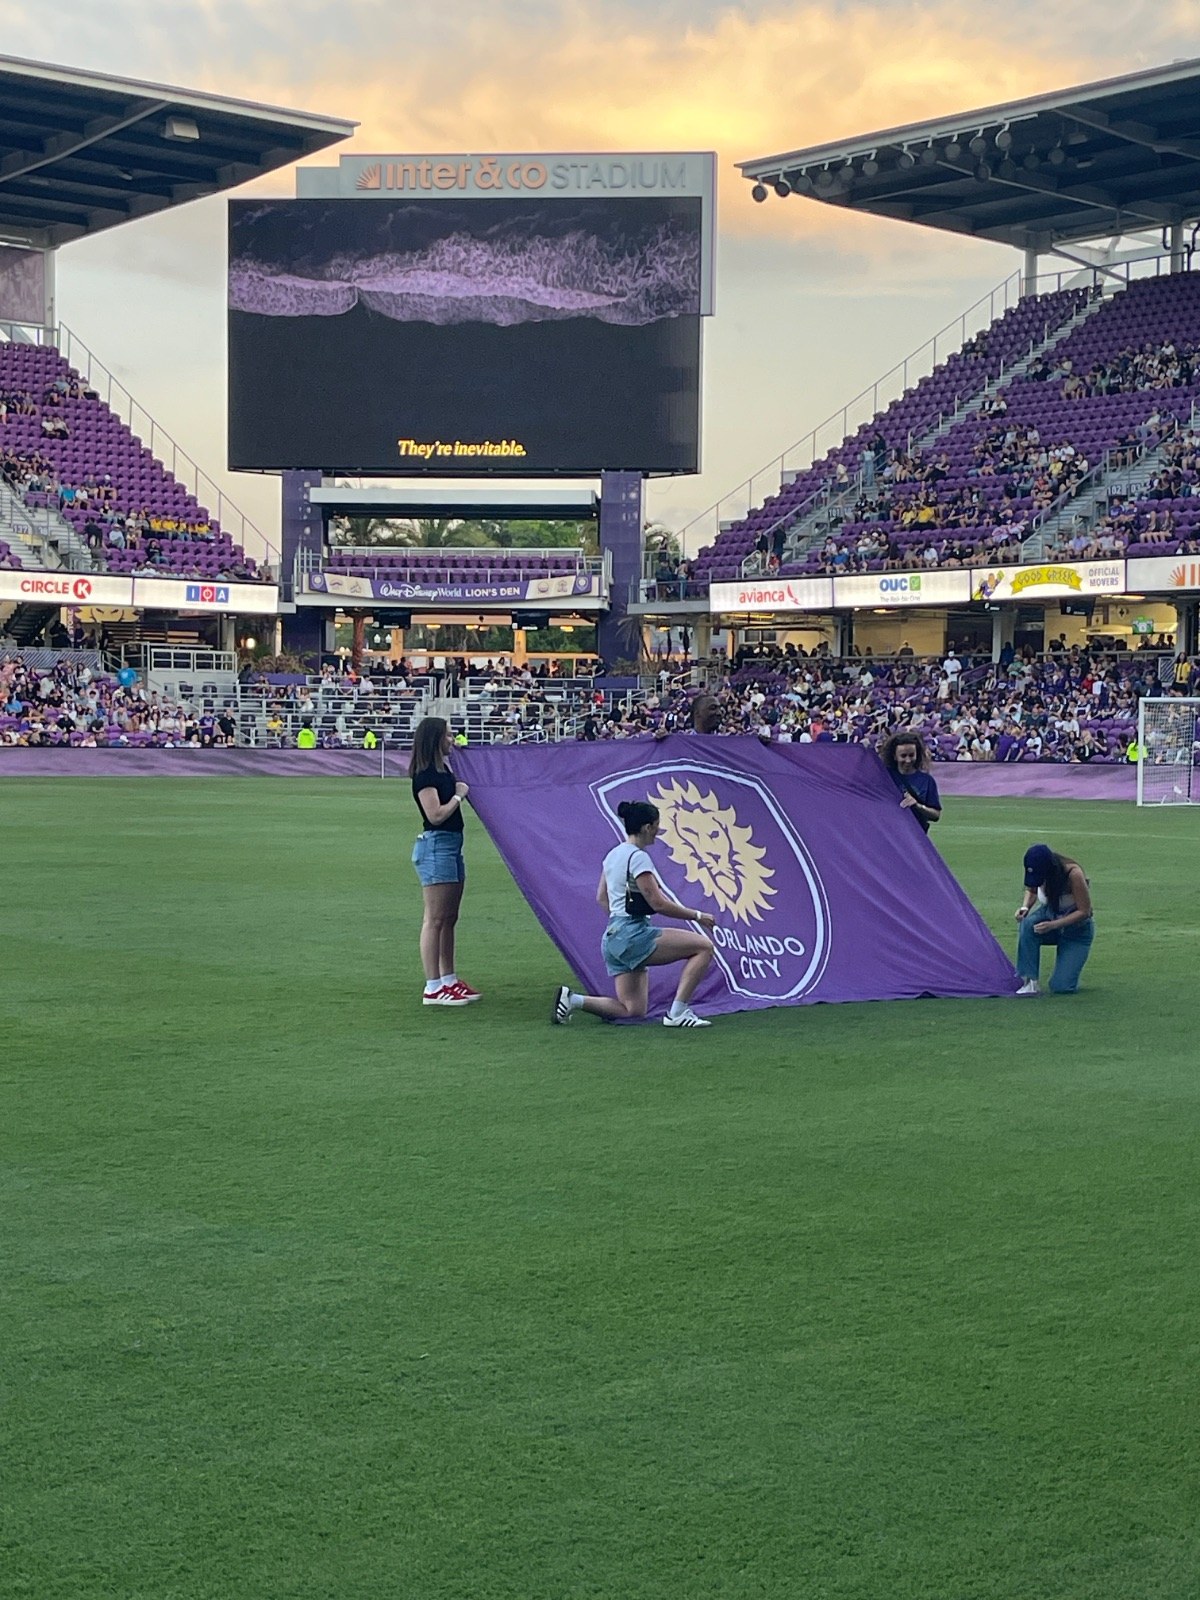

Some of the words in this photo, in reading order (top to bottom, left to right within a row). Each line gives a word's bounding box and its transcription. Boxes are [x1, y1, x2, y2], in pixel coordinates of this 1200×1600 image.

[551, 162, 686, 189] STADIUM
[398, 440, 453, 459] They're
[454, 440, 526, 456] inevitable.
[1018, 571, 1041, 585] GOOD
[1046, 569, 1073, 582] GREEK
[1089, 567, 1119, 576] OFFICIAL
[20, 580, 70, 594] CIRCLE
[880, 578, 908, 592] OUC
[1090, 577, 1118, 586] MOVERS
[437, 587, 462, 597] World
[465, 588, 497, 597] LION'S
[500, 587, 520, 596] DEN
[739, 589, 785, 604] avianca
[712, 925, 805, 956] ORLANDO
[740, 956, 781, 979] CITY
